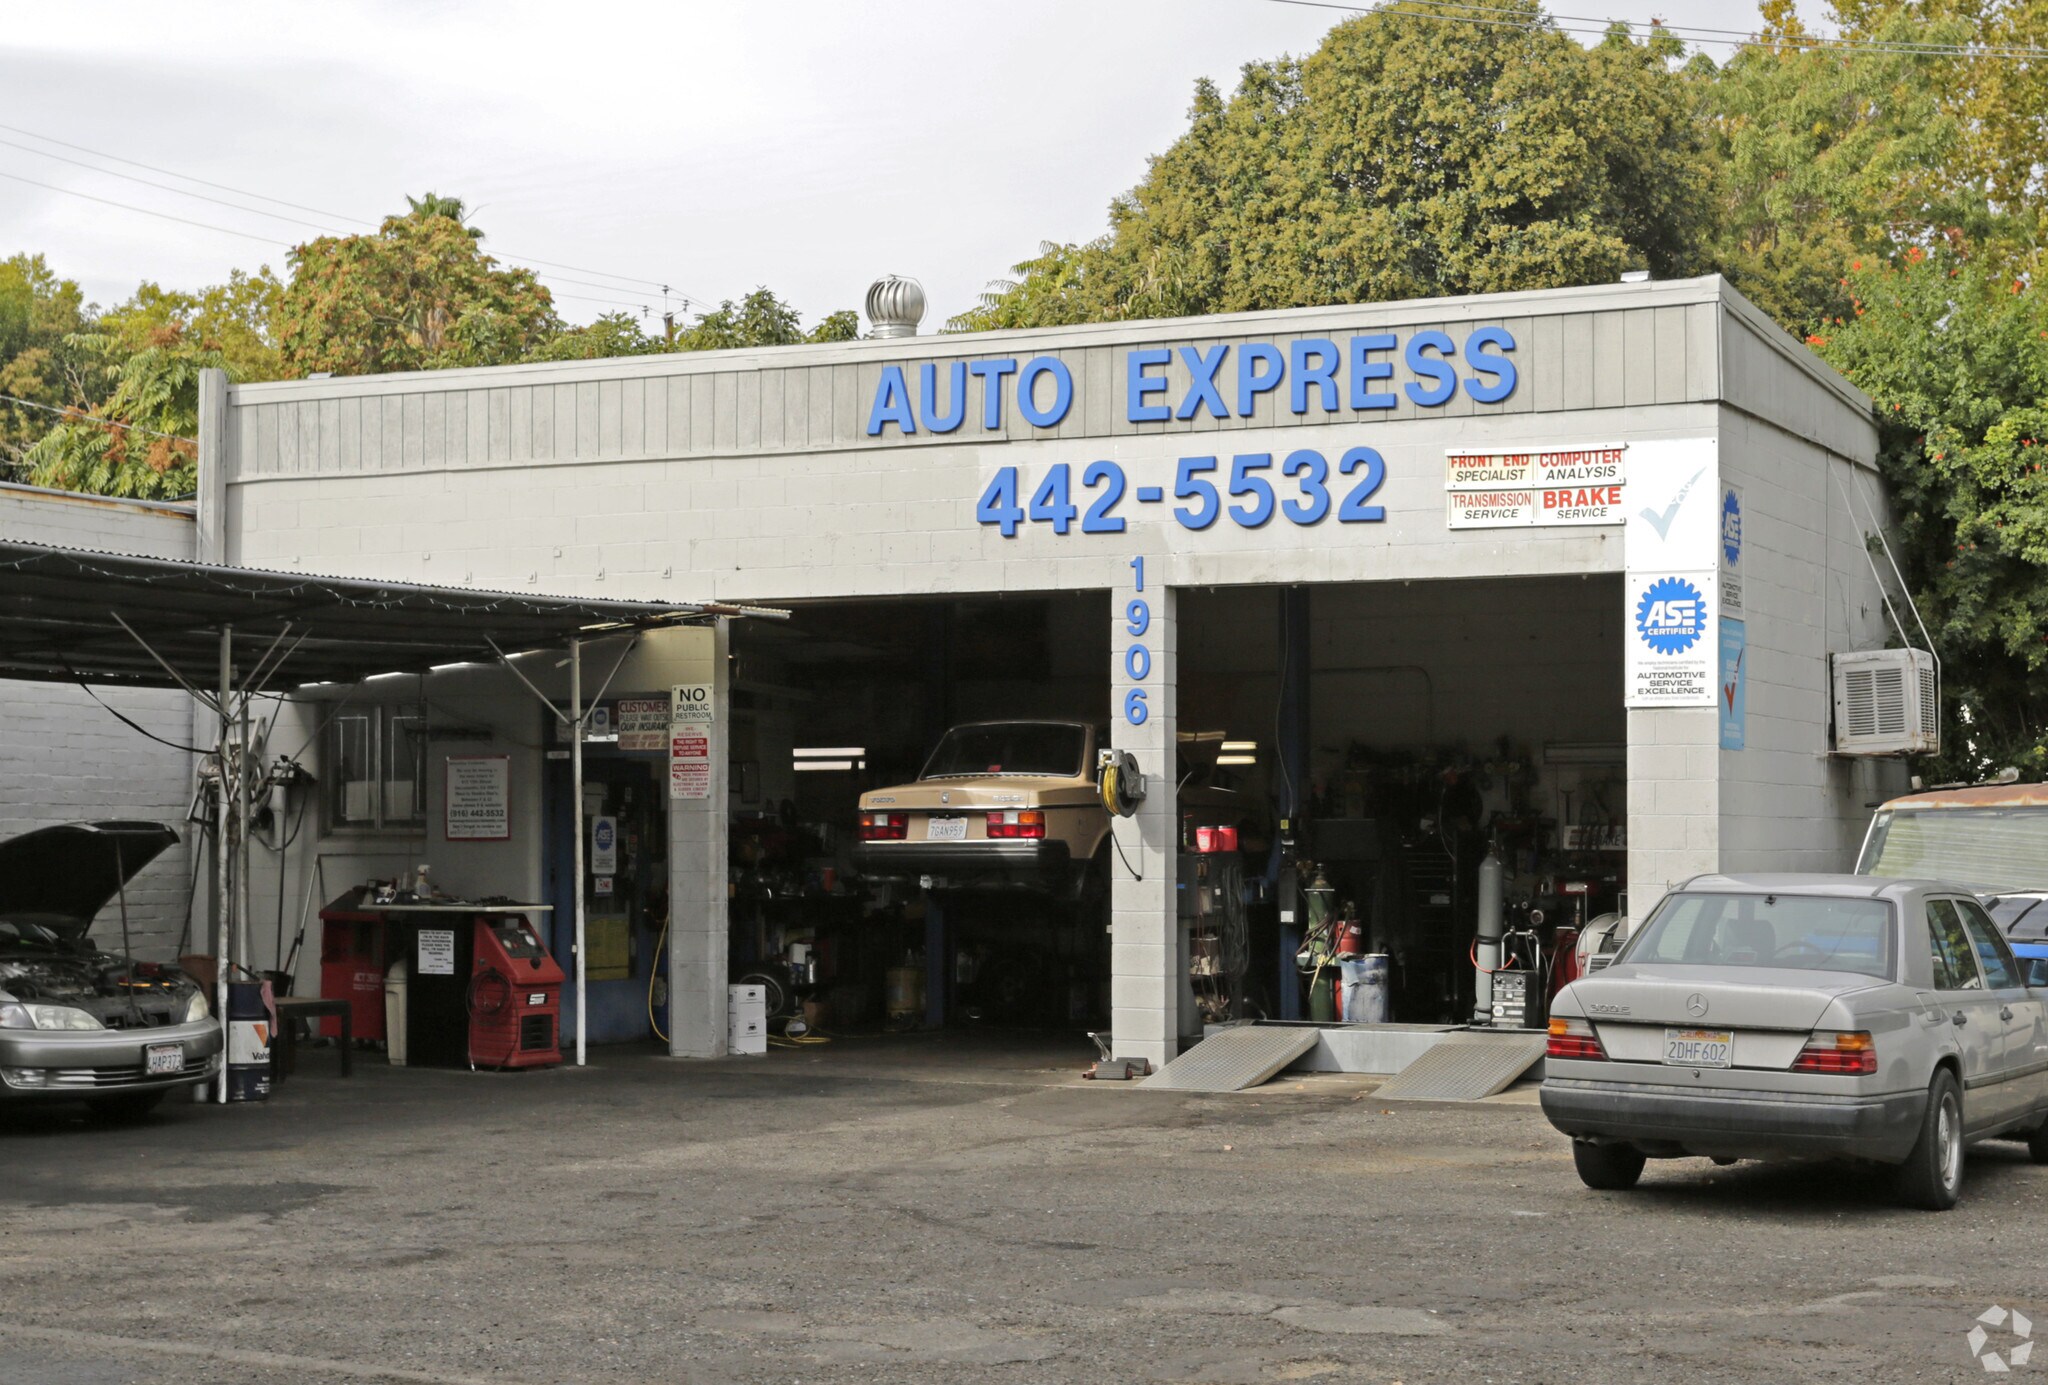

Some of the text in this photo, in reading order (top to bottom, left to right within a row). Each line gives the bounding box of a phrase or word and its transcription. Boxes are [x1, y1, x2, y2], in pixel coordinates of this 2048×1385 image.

[867, 326, 1517, 436] AUTO EXPRESS
[1451, 454, 1530, 468] FRONT END
[1540, 450, 1622, 467] COMPUTER
[1456, 469, 1526, 482] SPECIALIST
[1546, 465, 1616, 480] ANALYSIS
[976, 446, 1387, 537] 442-5532
[1543, 487, 1622, 509] BRAKE
[1453, 492, 1531, 508] TRANSMISSION
[1464, 509, 1519, 519] SERVICE
[1557, 507, 1608, 519] SERVICE
[1644, 600, 1696, 627] ASE
[1648, 627, 1695, 636] CERTIFIED
[1125, 556, 1150, 725] 1906
[680, 688, 706, 702] NO
[639, 721, 669, 731] INSURANC
[470, 809, 504, 817] 442-5532
[1668, 1042, 1727, 1061] 2DHF602
